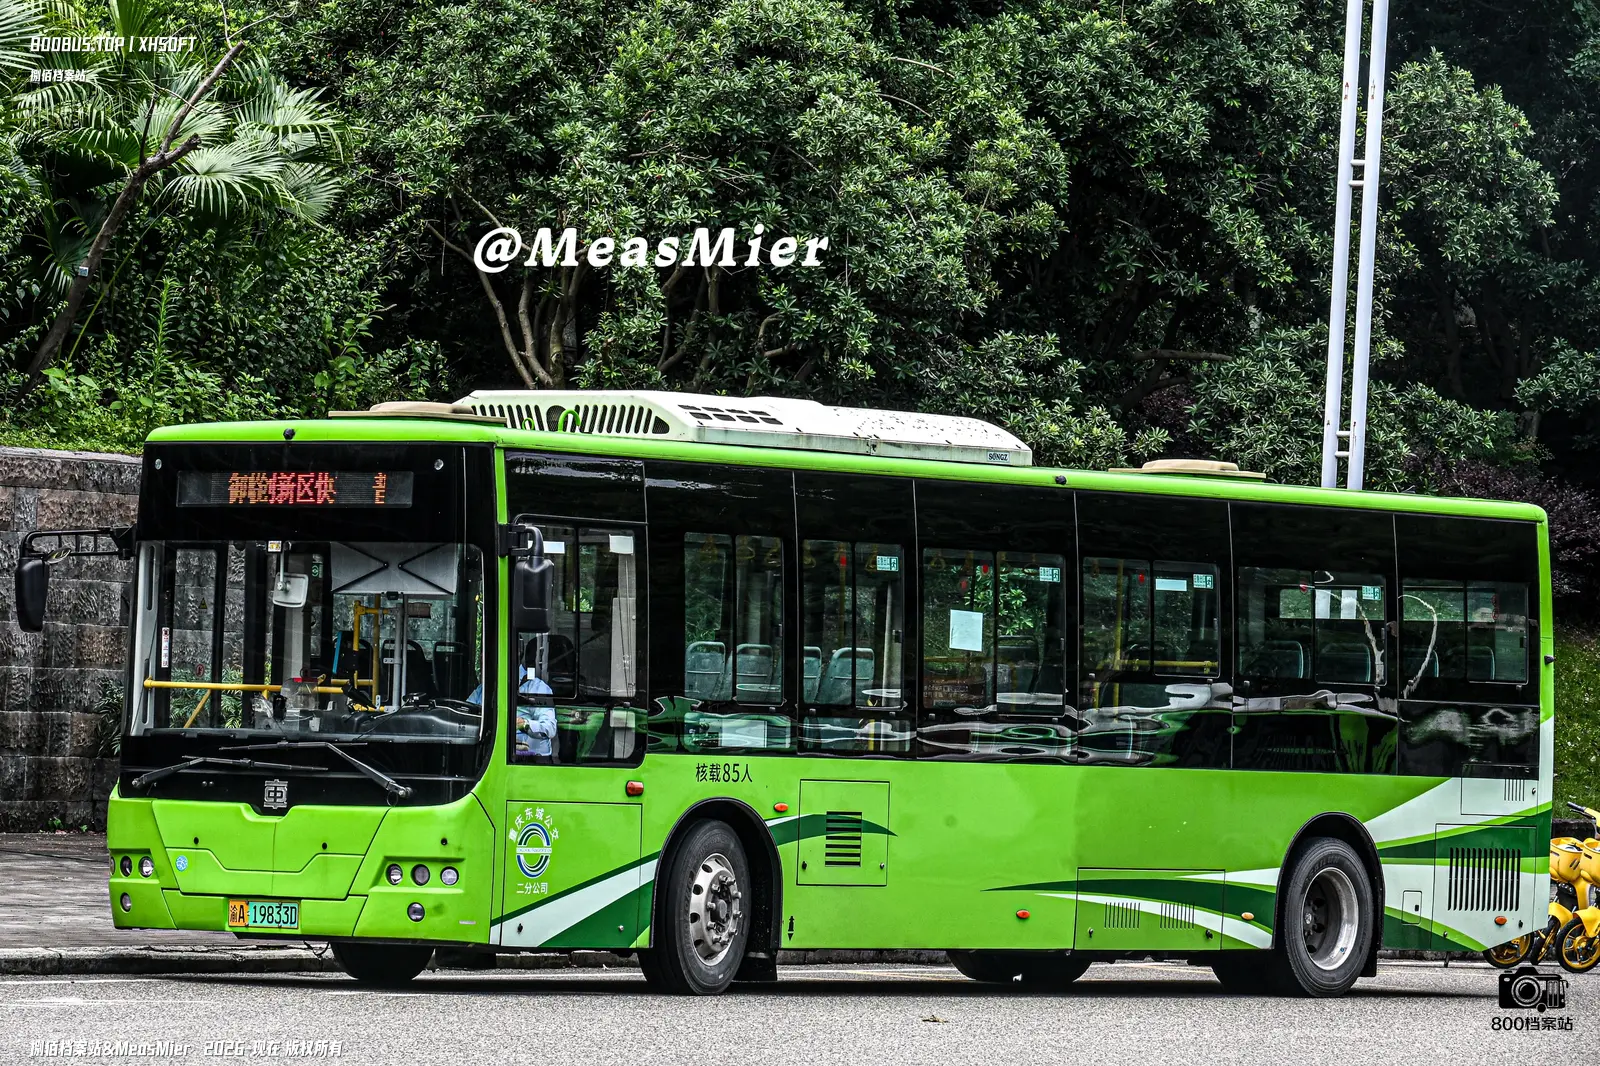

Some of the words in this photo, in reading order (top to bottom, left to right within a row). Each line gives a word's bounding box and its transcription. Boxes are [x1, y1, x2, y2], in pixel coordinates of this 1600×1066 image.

[695, 763, 753, 783] 核载85人
[516, 882, 548, 895] 二分公司
